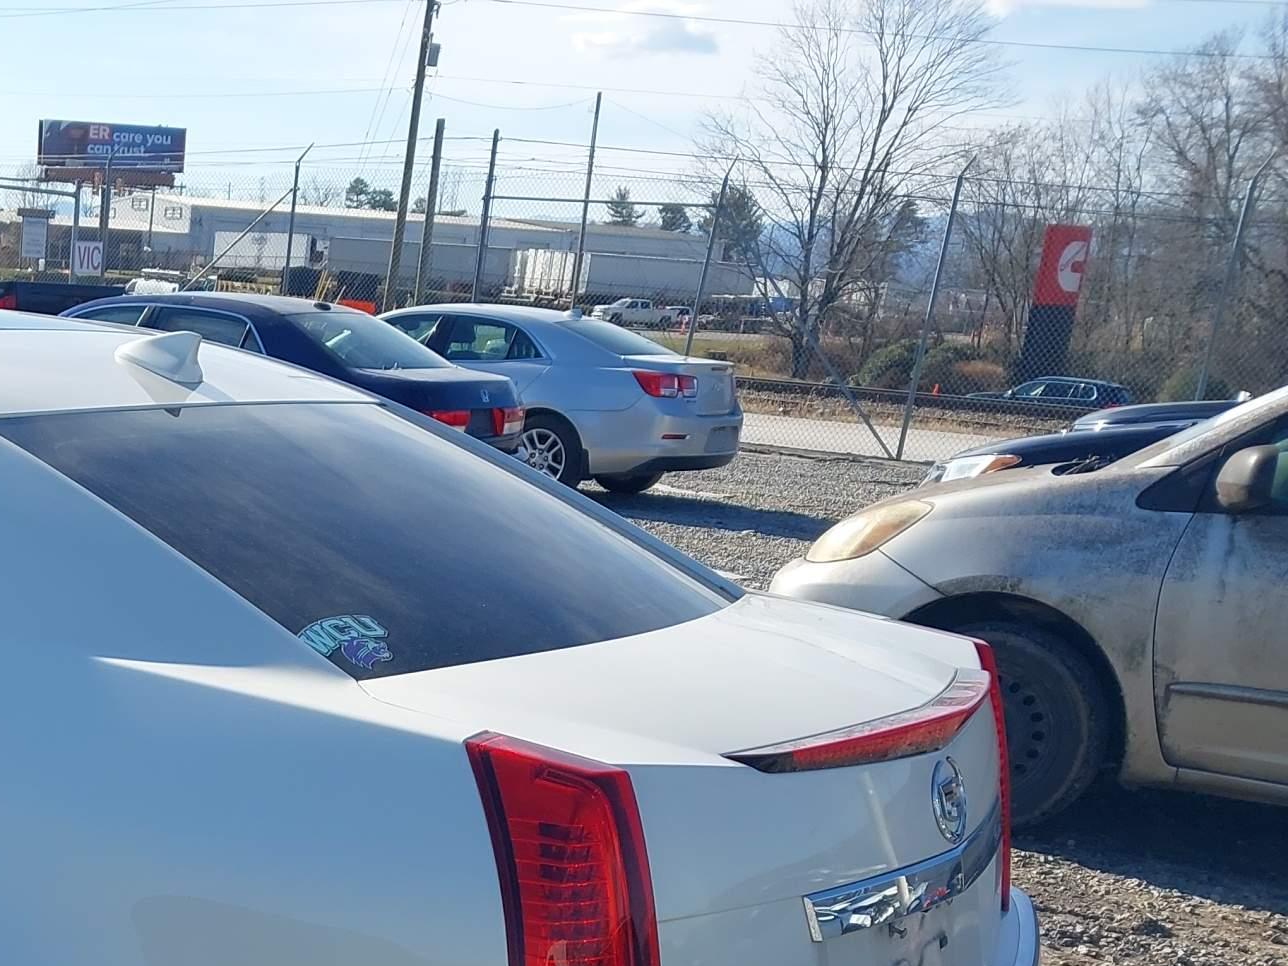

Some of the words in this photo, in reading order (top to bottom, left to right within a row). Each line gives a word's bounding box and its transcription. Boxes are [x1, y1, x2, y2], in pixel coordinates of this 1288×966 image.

[89, 125, 110, 140] ER
[113, 132, 143, 143] care
[146, 134, 172, 146] you
[87, 144, 112, 154] can
[112, 143, 145, 155] trust
[78, 245, 101, 270] VIC
[297, 614, 389, 657] WCU
